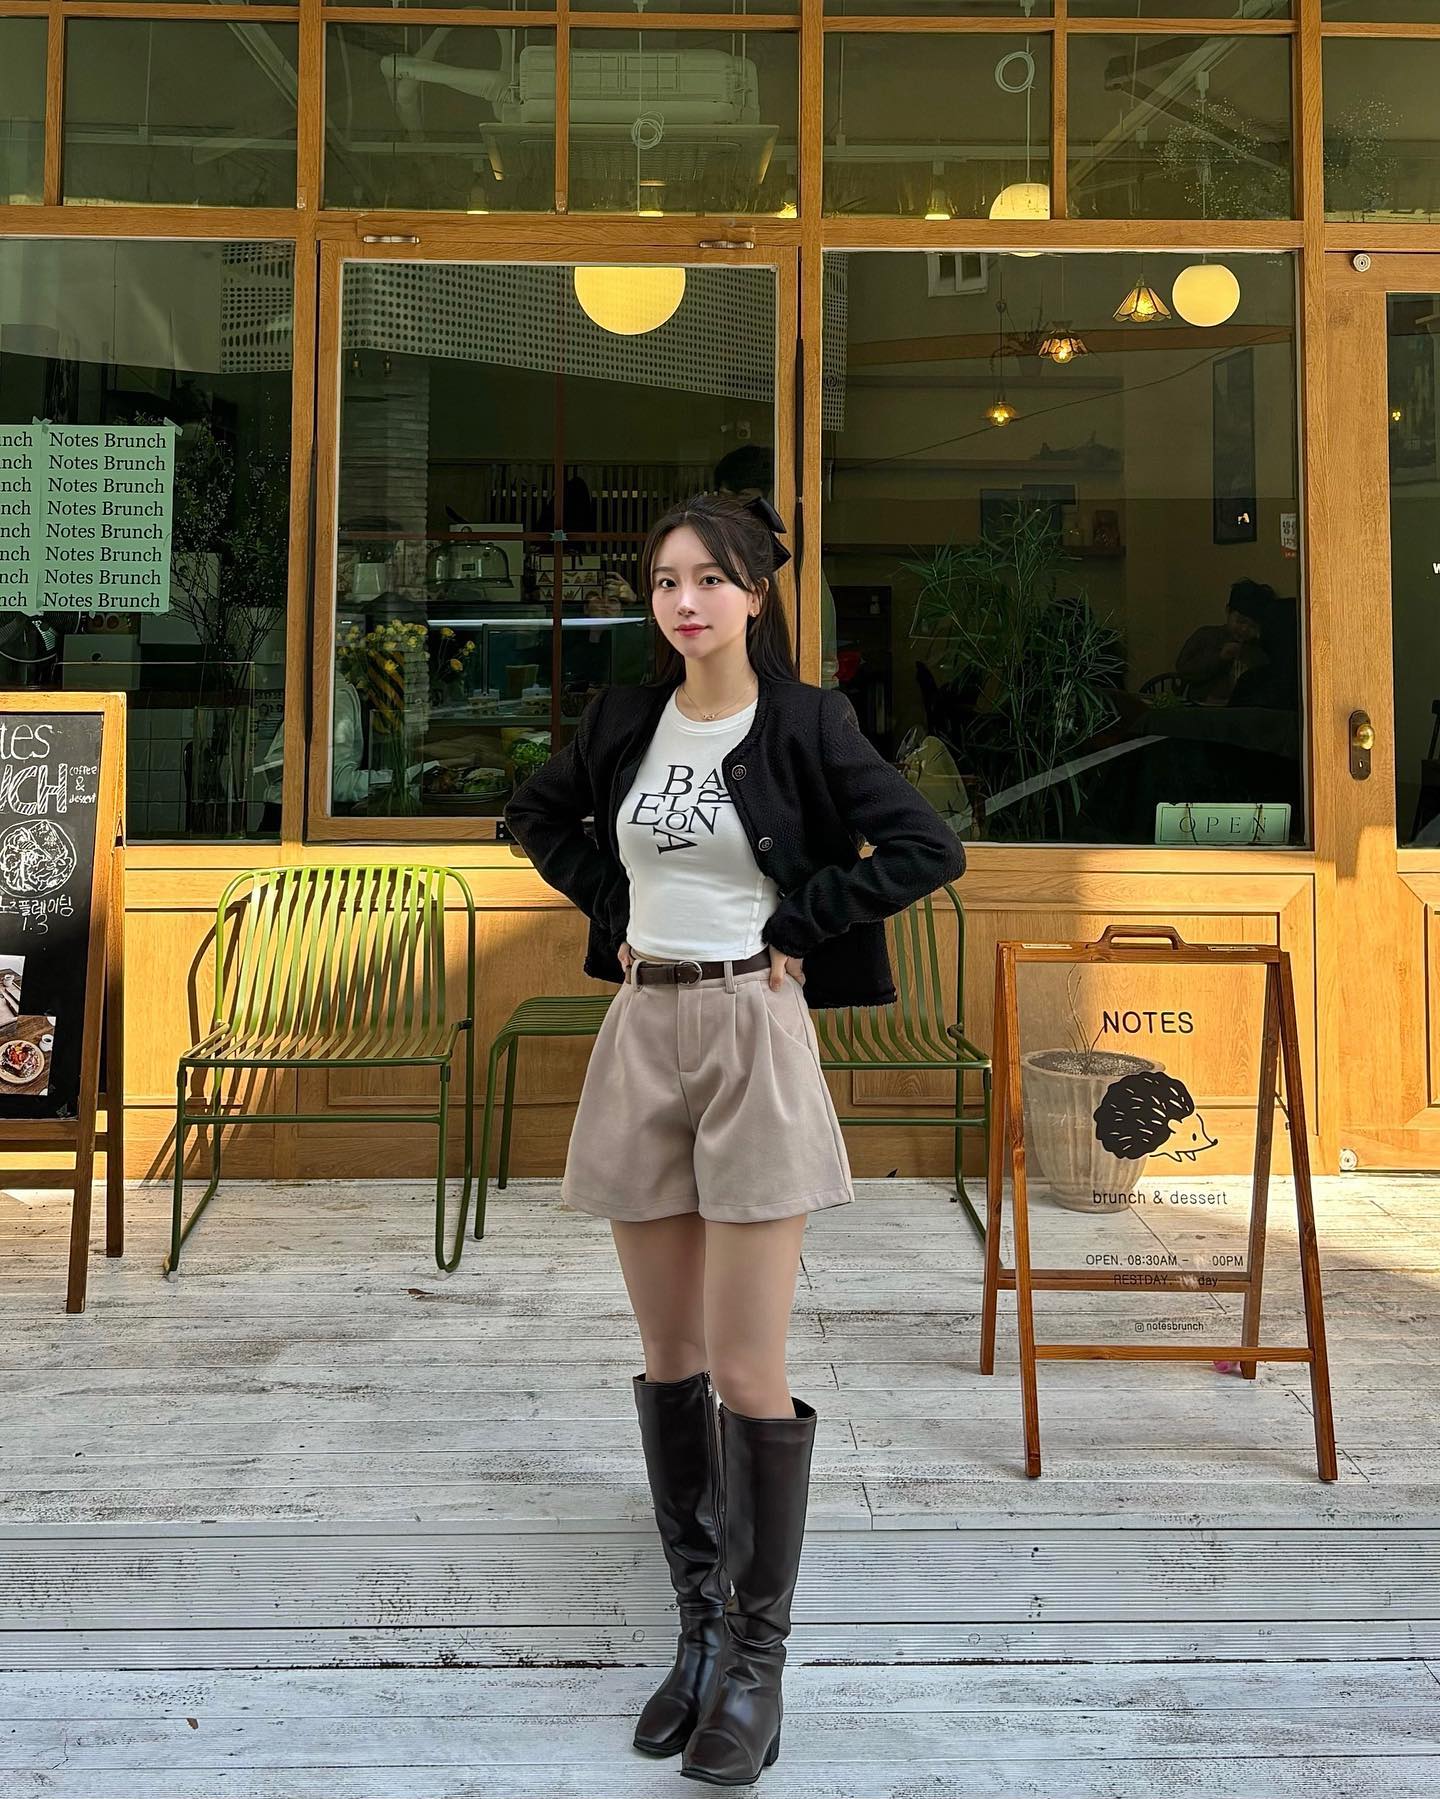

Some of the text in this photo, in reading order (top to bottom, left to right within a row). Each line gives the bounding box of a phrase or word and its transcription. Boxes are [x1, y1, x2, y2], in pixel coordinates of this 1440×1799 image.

[0, 432, 32, 446] nch
[49, 432, 166, 448] Notes Brunch
[0, 454, 32, 469] nch
[49, 455, 165, 470] Notes Brunch
[48, 478, 164, 493] Notes Brunch
[48, 501, 163, 516] Notes Brunch
[46, 524, 162, 539] Notes Brunch
[45, 547, 161, 562] Notes Brunch
[45, 570, 161, 584] Notes Brunch
[43, 593, 159, 607] Notes Brunch
[69, 765, 98, 776] coffee
[69, 792, 97, 804] dessert
[1179, 816, 1266, 834] OPEN
[1103, 1011, 1194, 1033] NOTES
[1093, 1190, 1228, 1204] brunch & dessert
[1127, 1254, 1178, 1266] 08:30AM
[1146, 1321, 1204, 1331] notesbrunch
